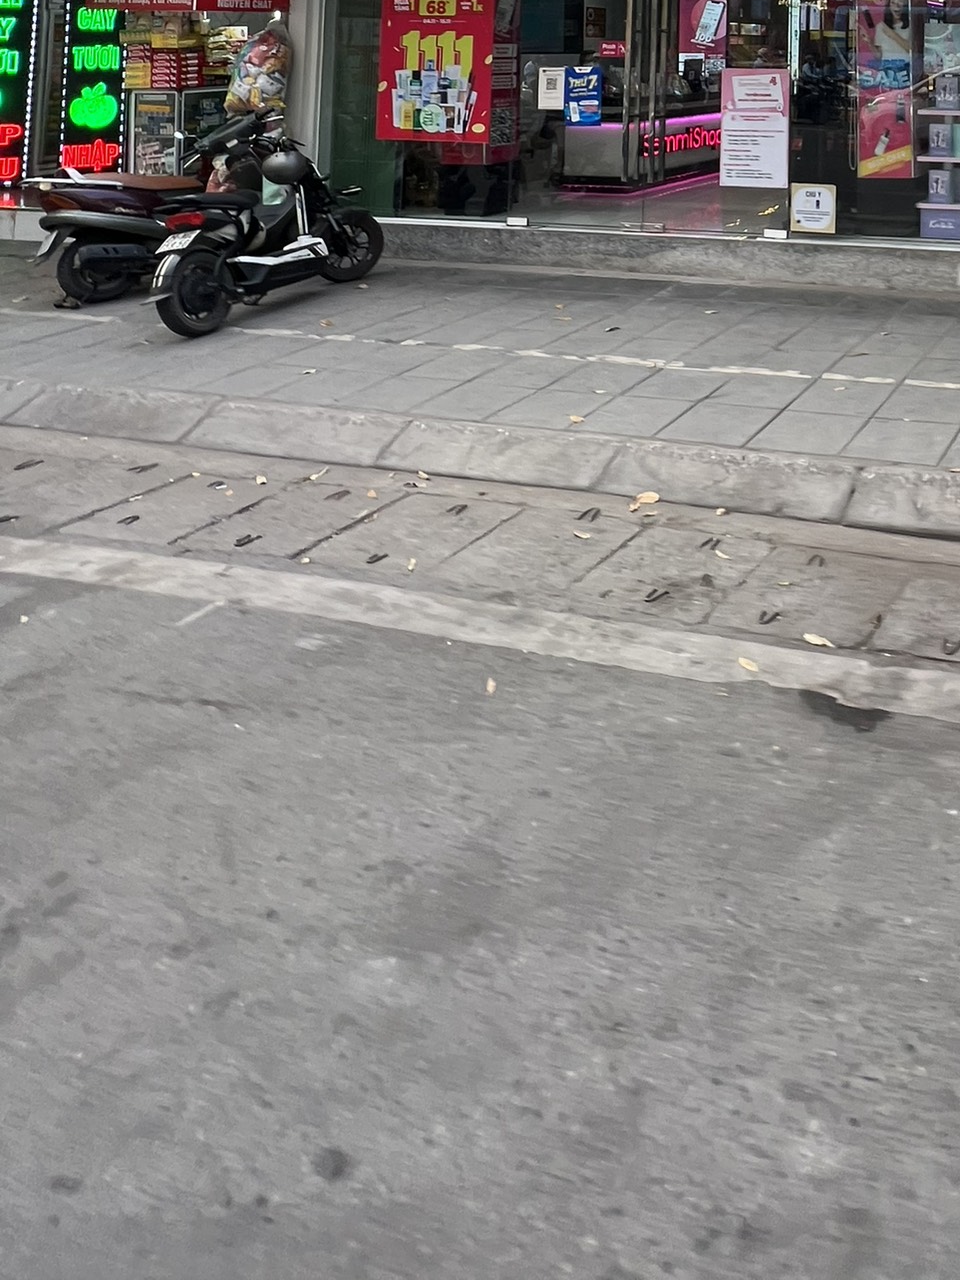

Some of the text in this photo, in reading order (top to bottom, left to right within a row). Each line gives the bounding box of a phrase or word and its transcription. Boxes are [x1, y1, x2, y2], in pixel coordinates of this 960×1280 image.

[72, 44, 120, 71] TƯƠI
[859, 69, 911, 90] SALE
[62, 138, 119, 171] NHẬP
